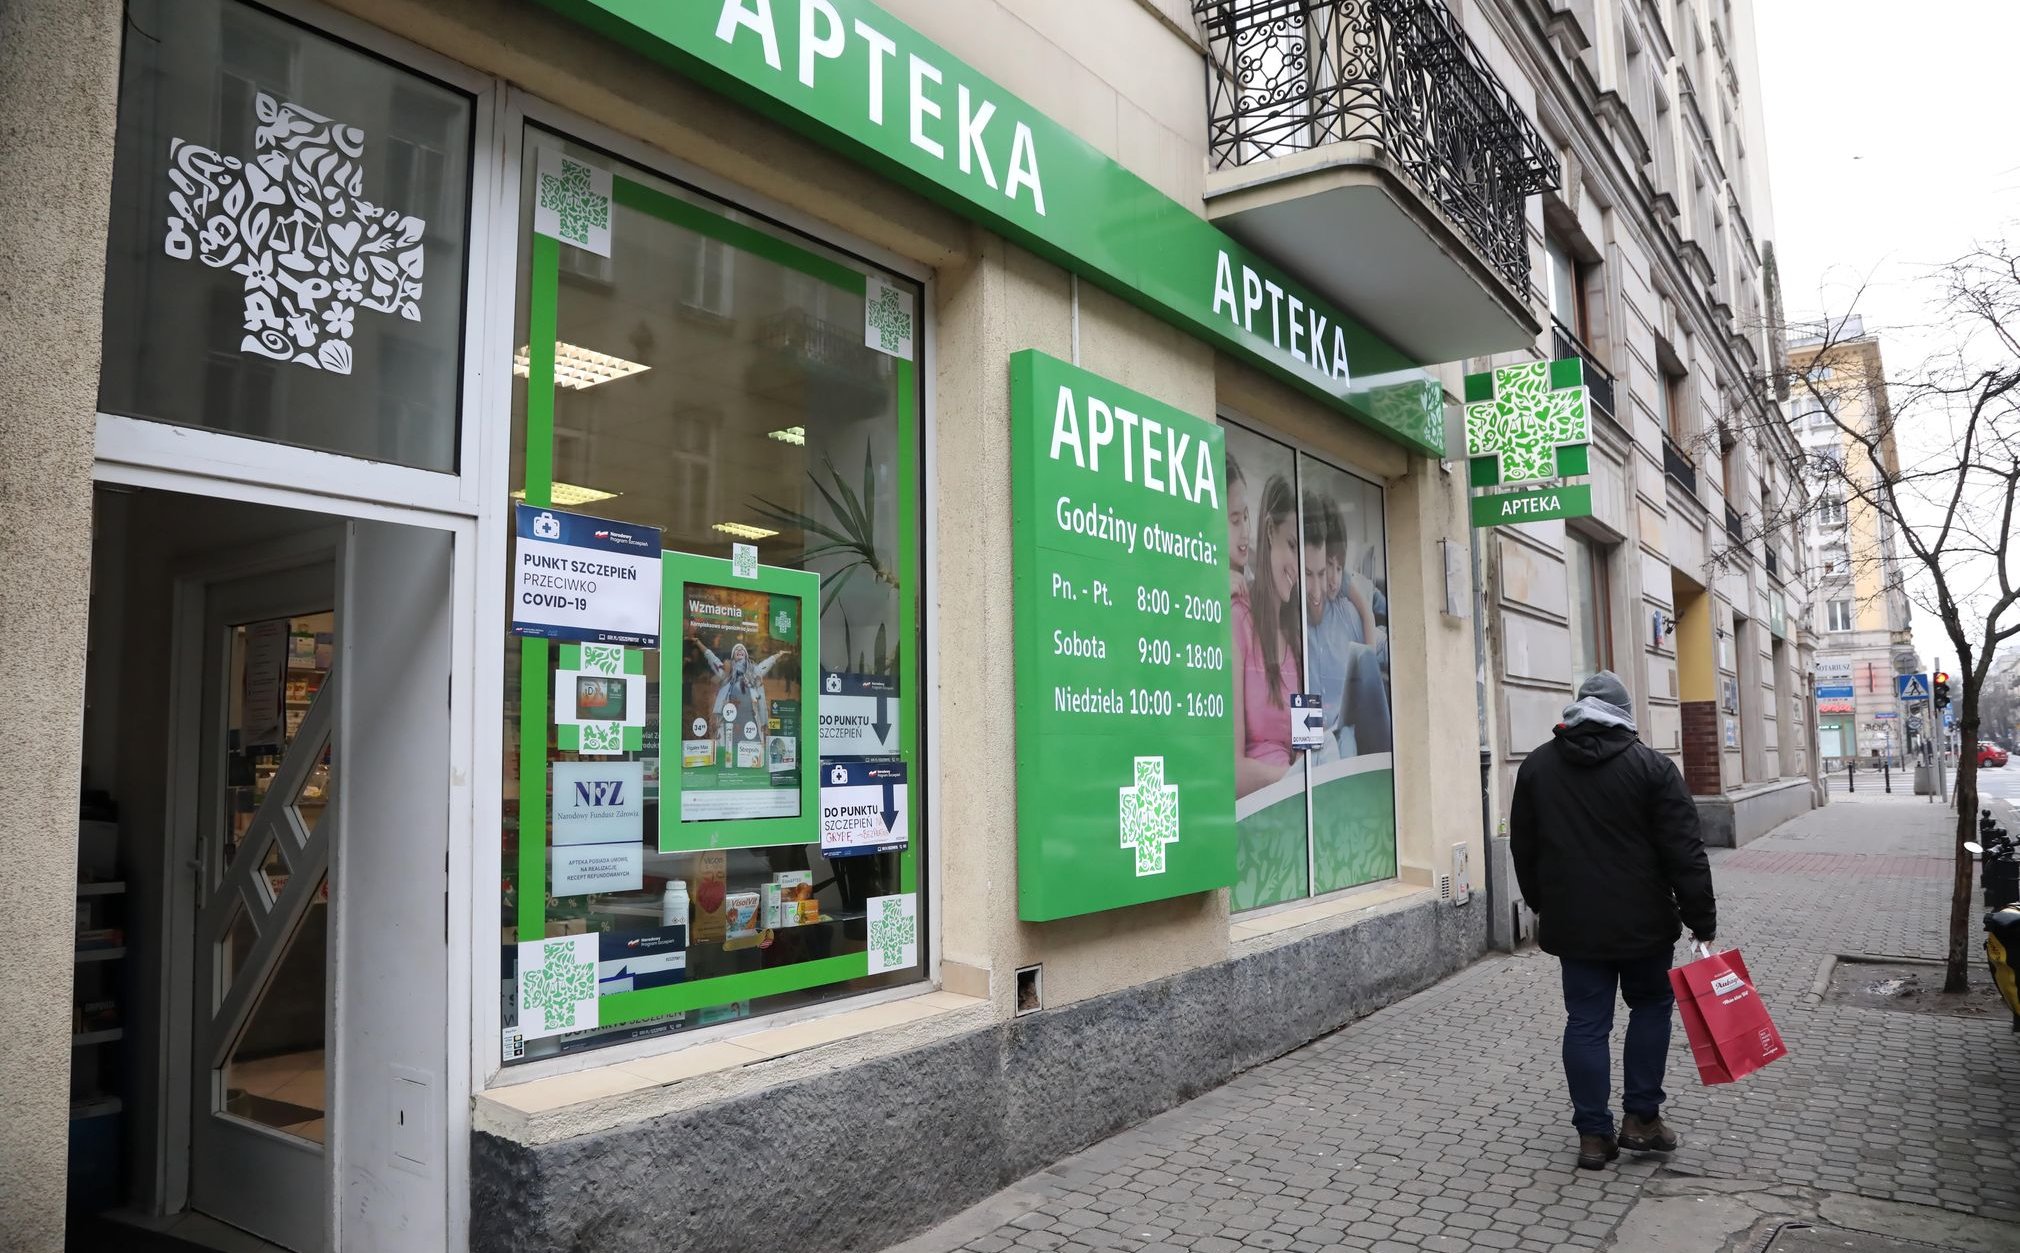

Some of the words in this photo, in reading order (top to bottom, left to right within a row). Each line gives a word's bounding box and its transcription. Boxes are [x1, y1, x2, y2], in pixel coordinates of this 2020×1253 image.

[714, 0, 1047, 218] APTEKA
[1212, 248, 1352, 389] APTEKA
[1049, 384, 1219, 511] APTEKA
[1501, 494, 1561, 517] APTEKA
[1056, 496, 1137, 553] Godziny
[1143, 523, 1218, 565] otwarcia:
[523, 553, 569, 571] PUNKT
[571, 560, 637, 580] SZCZEPIEŃ
[523, 572, 597, 593] PRZECIWKO
[522, 592, 587, 611] COVID-19
[688, 599, 742, 617] Wzmacnia
[1052, 572, 1077, 600] Pn.
[1093, 580, 1113, 606] Pt.
[1137, 586, 1170, 615] 8:00
[1184, 594, 1222, 624] 20:00
[1054, 629, 1106, 659] Sobota
[1138, 637, 1171, 666] 9:00
[1185, 643, 1223, 670] 18:00
[1055, 686, 1124, 714] Niedziela
[1129, 688, 1172, 716] 10:00
[1187, 693, 1224, 718] 16:00
[819, 715, 833, 725] DO
[834, 715, 870, 726] PUNKTU
[819, 725, 862, 739] SZCZEPIEŃ
[574, 780, 625, 807] NFZ
[557, 811, 588, 821] Narodowy
[590, 810, 614, 819] Fundusz
[615, 809, 640, 818] Zdrowia
[824, 807, 839, 818] DO
[840, 805, 878, 817] PUNKTU
[824, 816, 873, 831] SZCZEPIEŃ
[588, 864, 617, 872] REALIZACJĘ
[589, 857, 610, 865] POSIADA
[587, 871, 630, 880] REFUNDOWANYCH
